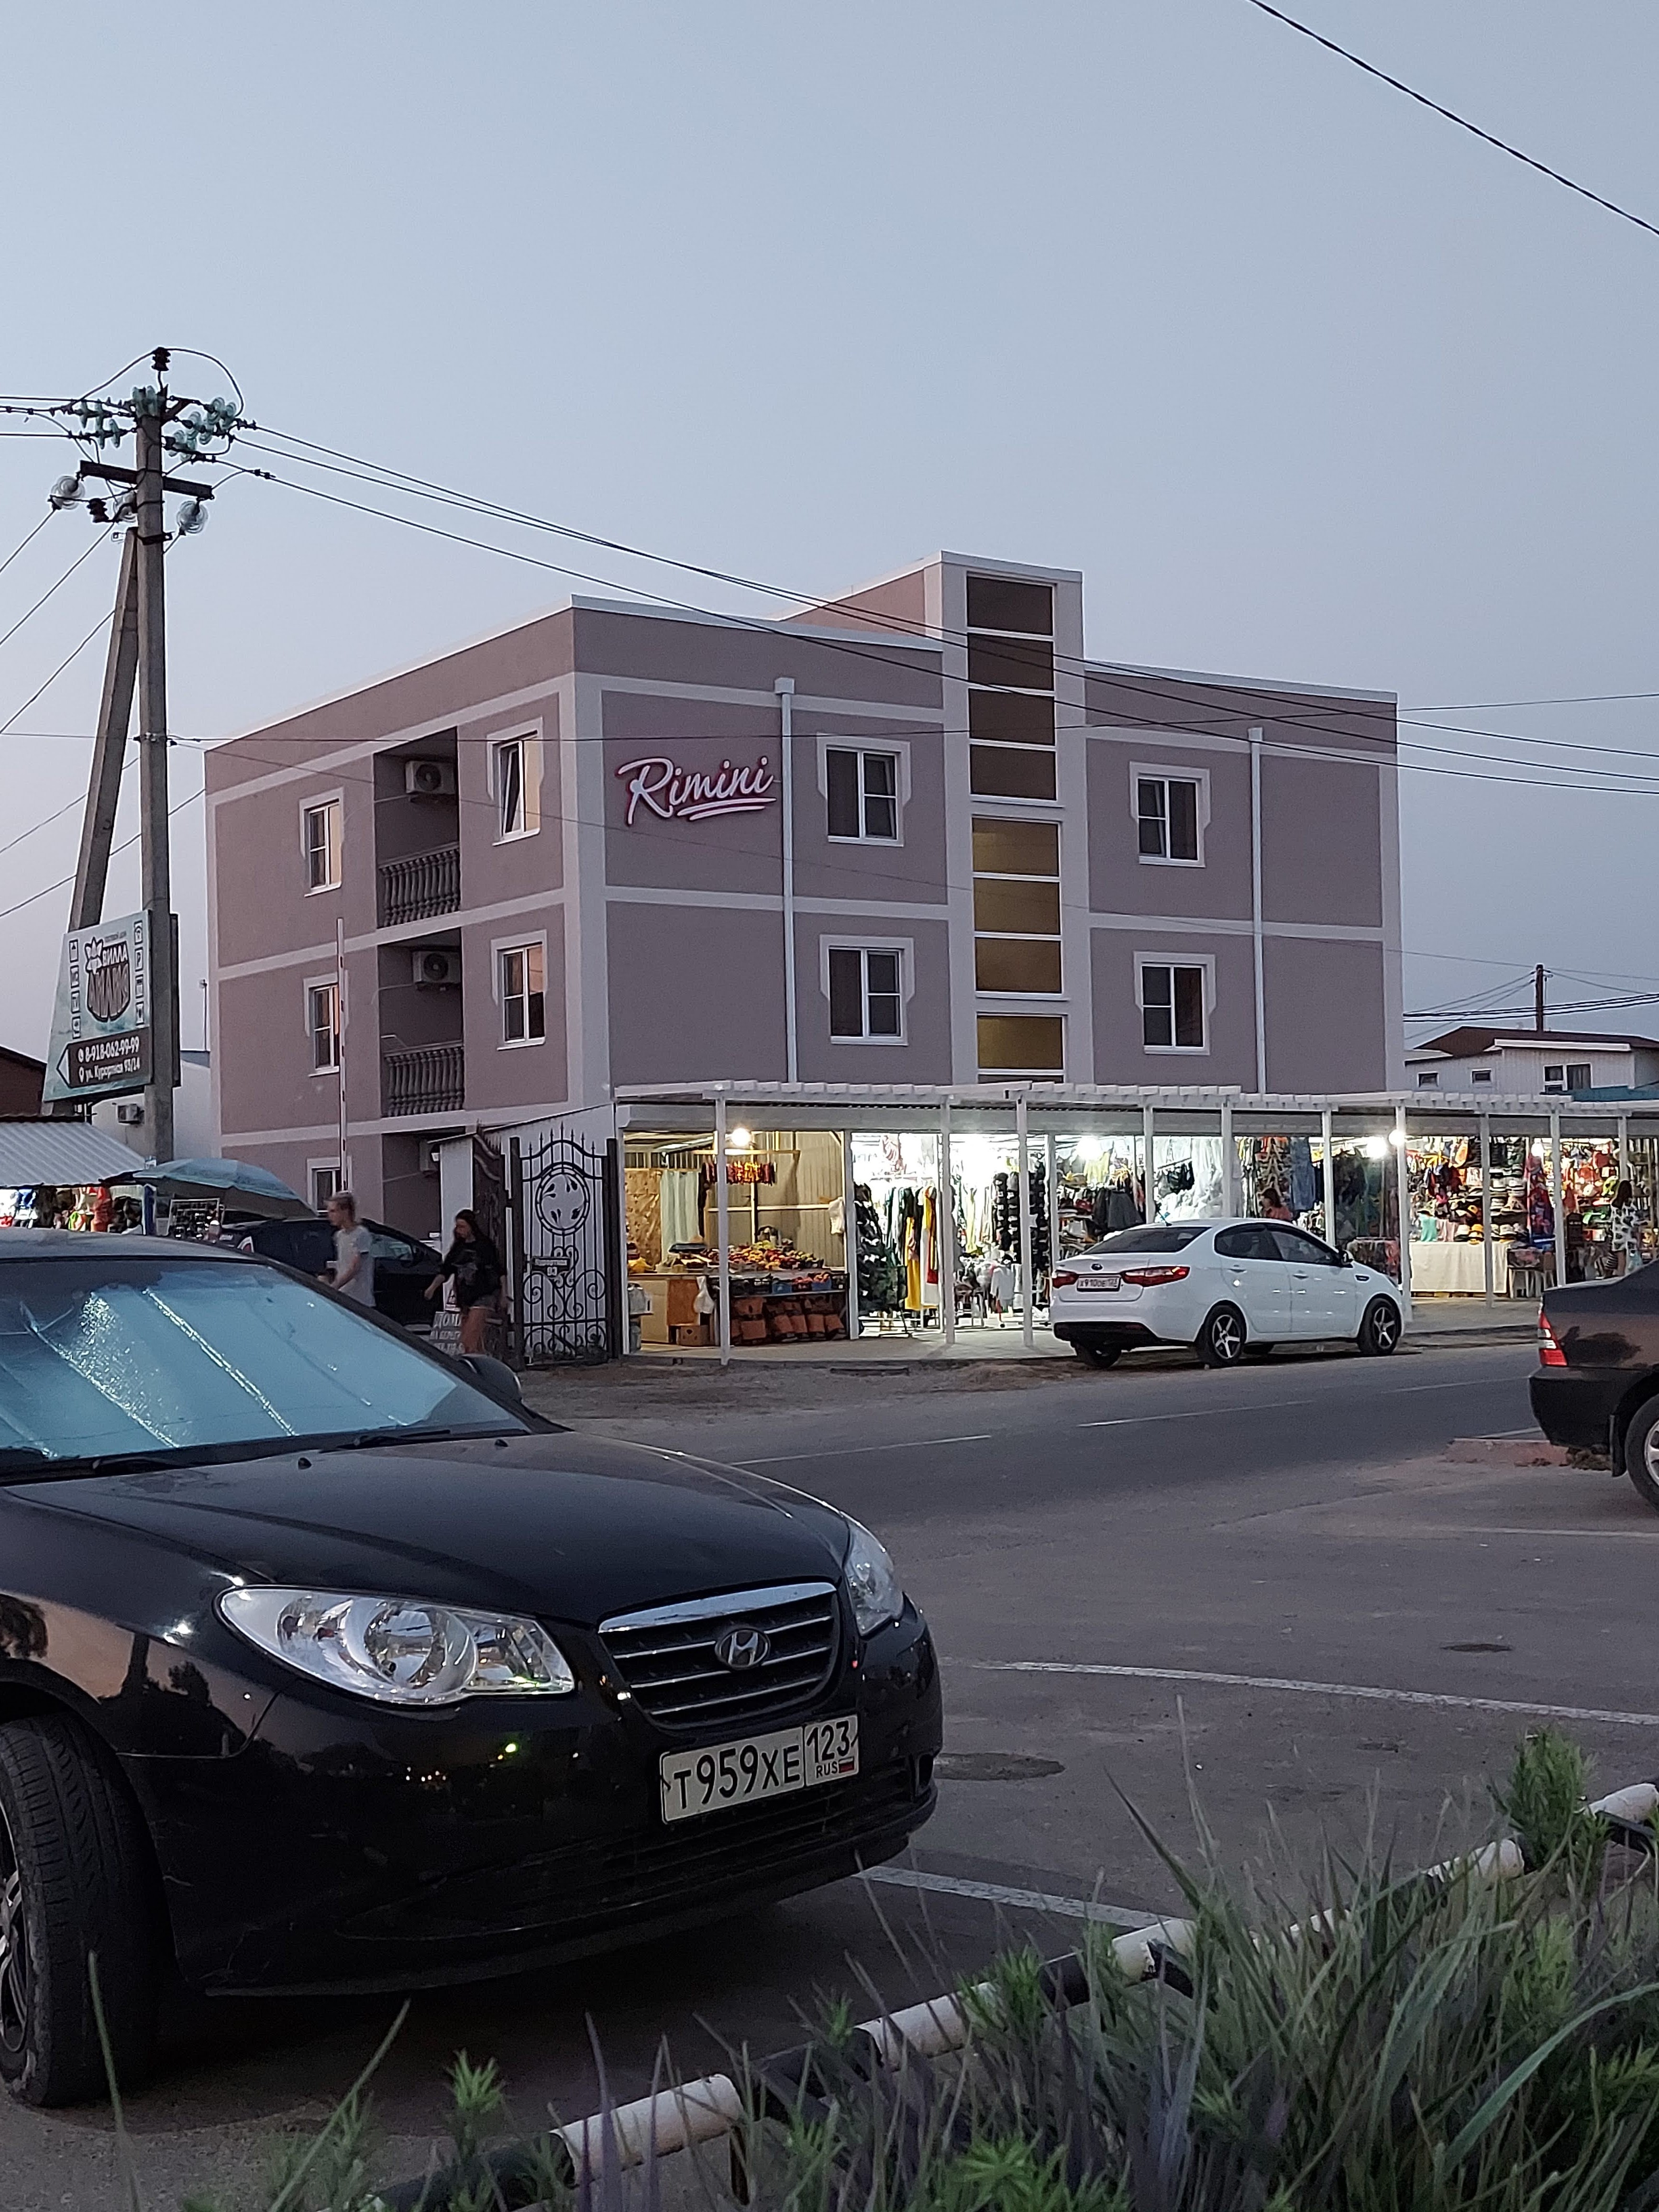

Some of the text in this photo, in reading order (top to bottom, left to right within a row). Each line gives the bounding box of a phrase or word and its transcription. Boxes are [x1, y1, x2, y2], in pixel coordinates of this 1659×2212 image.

[618, 756, 774, 825] Rimini
[102, 943, 128, 967] ВИЛЛА
[85, 1036, 140, 1062] 8-918-062-99-99
[674, 1720, 850, 1809] Т959ХЕ 123
[816, 1761, 838, 1779] RUS
